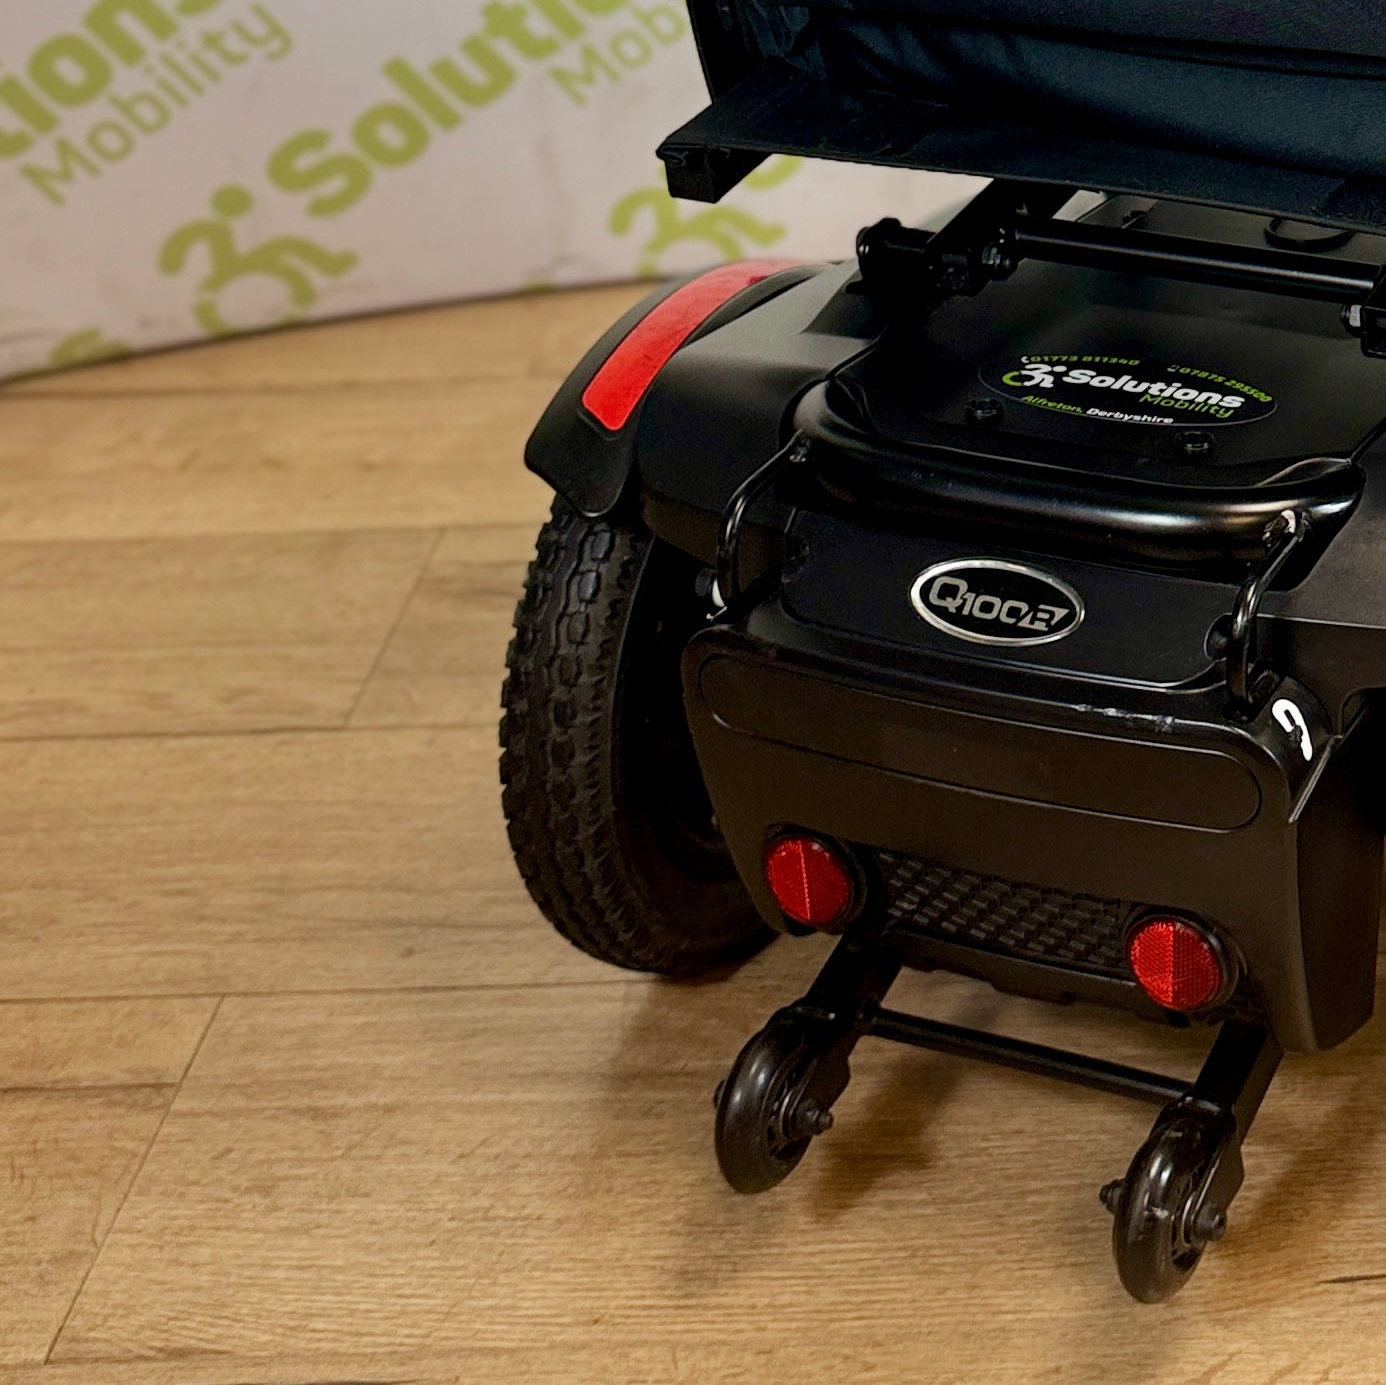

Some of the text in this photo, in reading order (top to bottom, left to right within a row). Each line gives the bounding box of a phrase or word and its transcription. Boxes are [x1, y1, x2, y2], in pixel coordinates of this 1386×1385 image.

[20, 3, 293, 204] Mobility
[1062, 369, 1245, 408] Solutions
[1085, 408, 1174, 423] Derbyshire
[1139, 394, 1234, 418] Mobility
